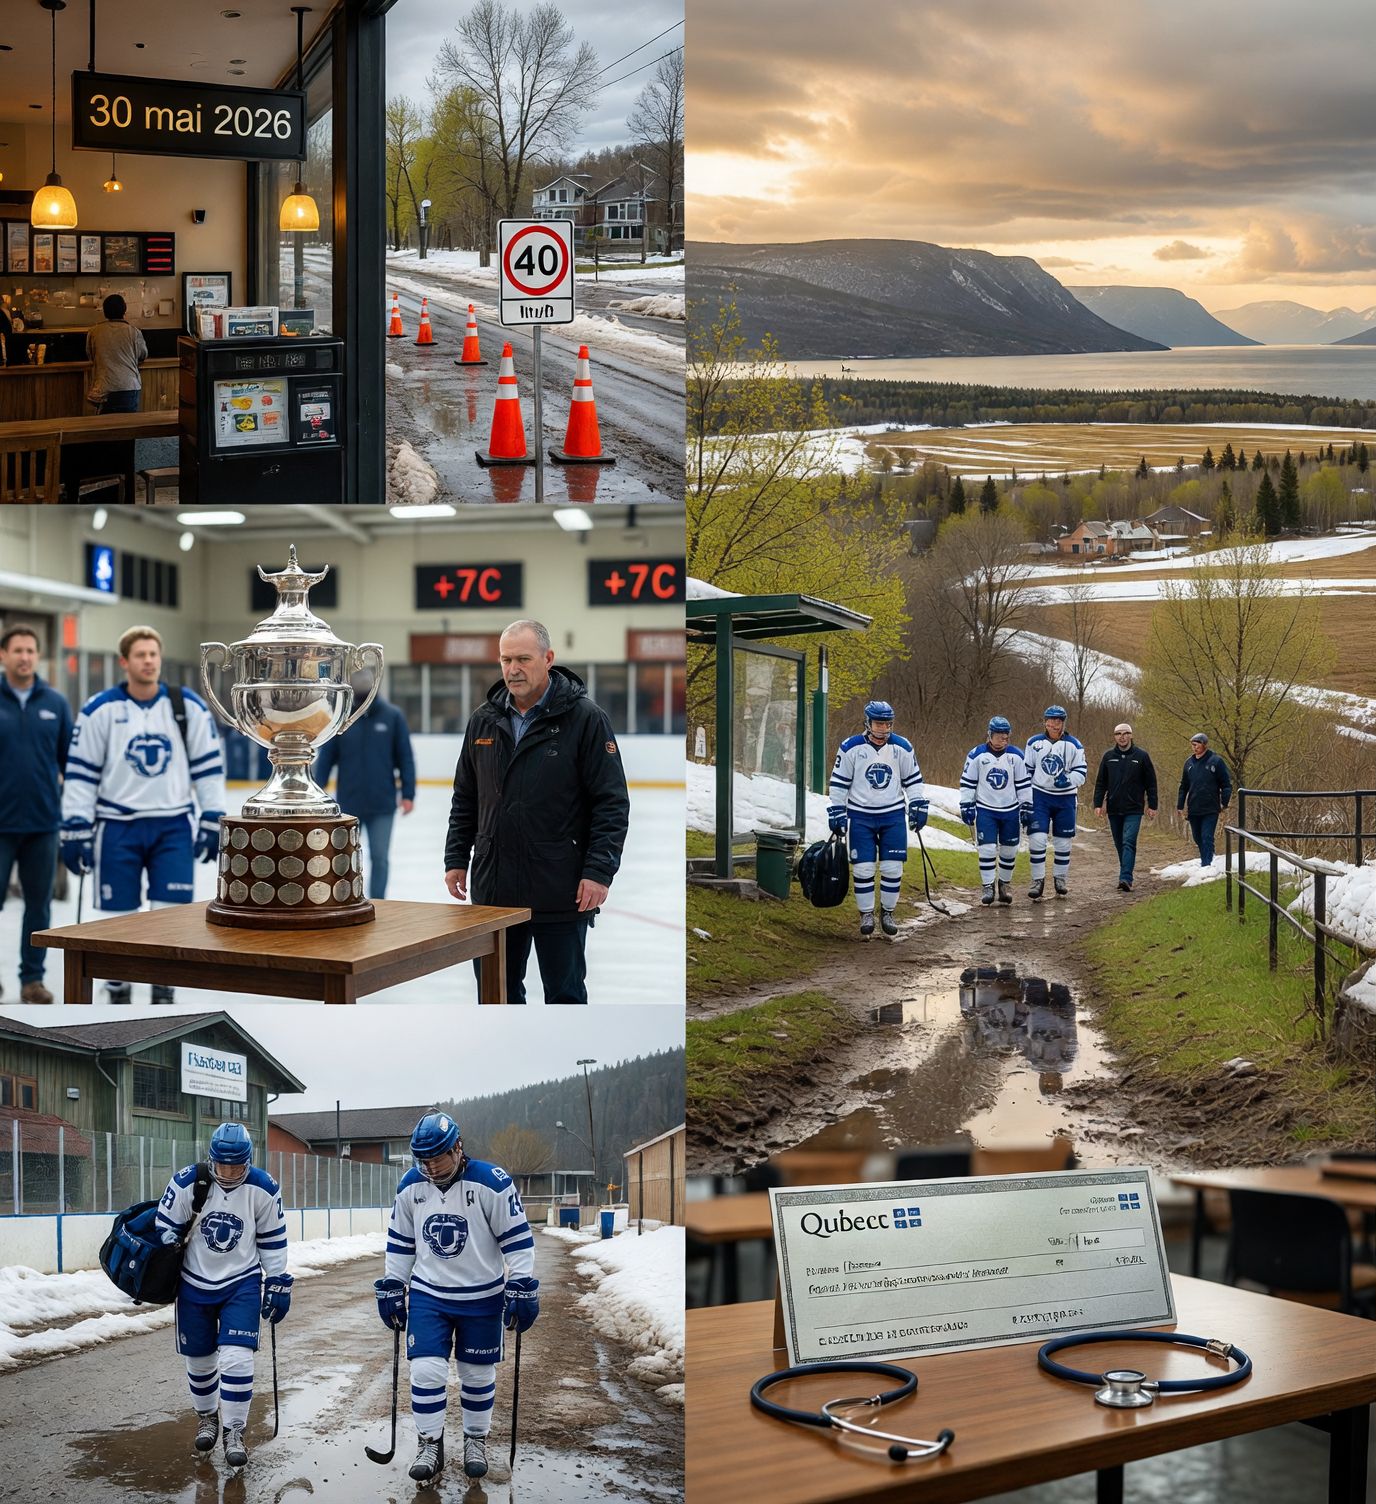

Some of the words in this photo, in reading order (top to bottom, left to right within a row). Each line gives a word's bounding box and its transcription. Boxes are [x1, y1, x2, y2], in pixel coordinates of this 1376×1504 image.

[89, 94, 133, 128] 30
[145, 103, 202, 133] mai
[213, 104, 293, 140] 2026
[514, 244, 559, 276] 40
[433, 567, 502, 602] +7C
[604, 563, 677, 599] +7C
